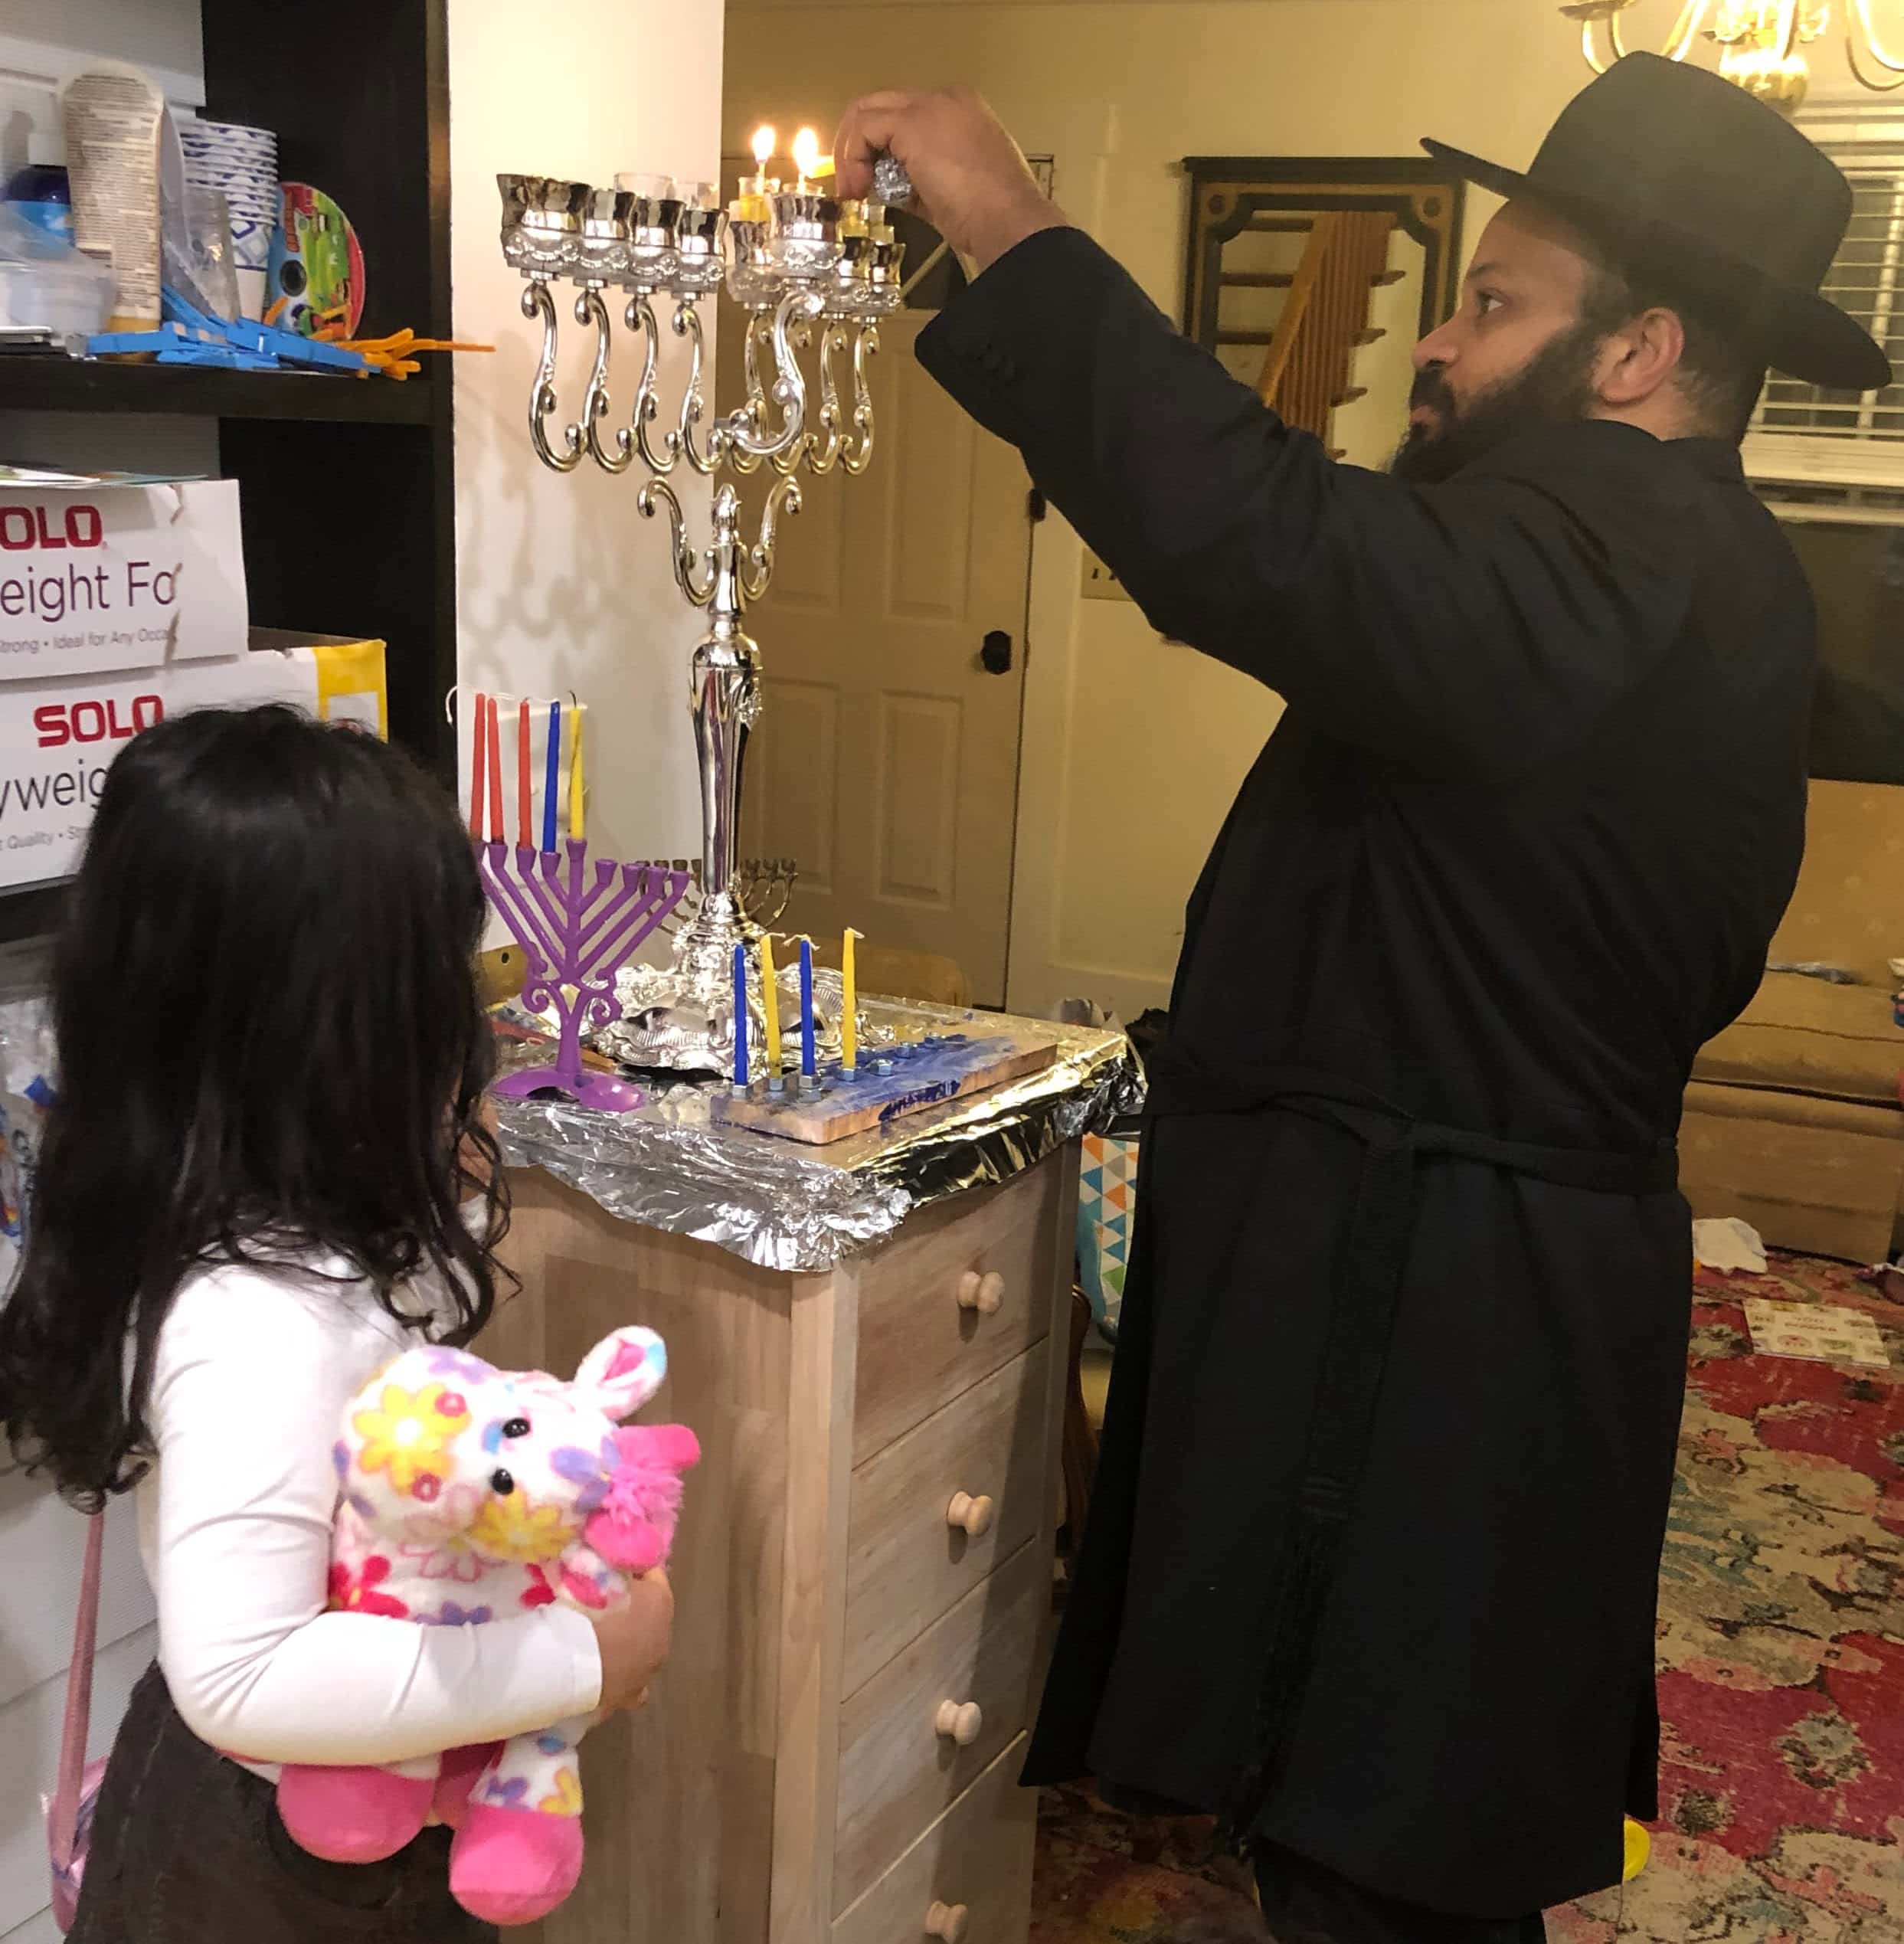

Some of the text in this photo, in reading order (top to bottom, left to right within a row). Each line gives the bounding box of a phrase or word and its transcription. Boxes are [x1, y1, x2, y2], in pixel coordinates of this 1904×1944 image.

[0, 506, 103, 550] OLO
[0, 563, 110, 623] eight
[0, 638, 39, 653] trong
[88, 631, 106, 646] for
[110, 630, 133, 646] Any
[34, 695, 164, 748] SOLO
